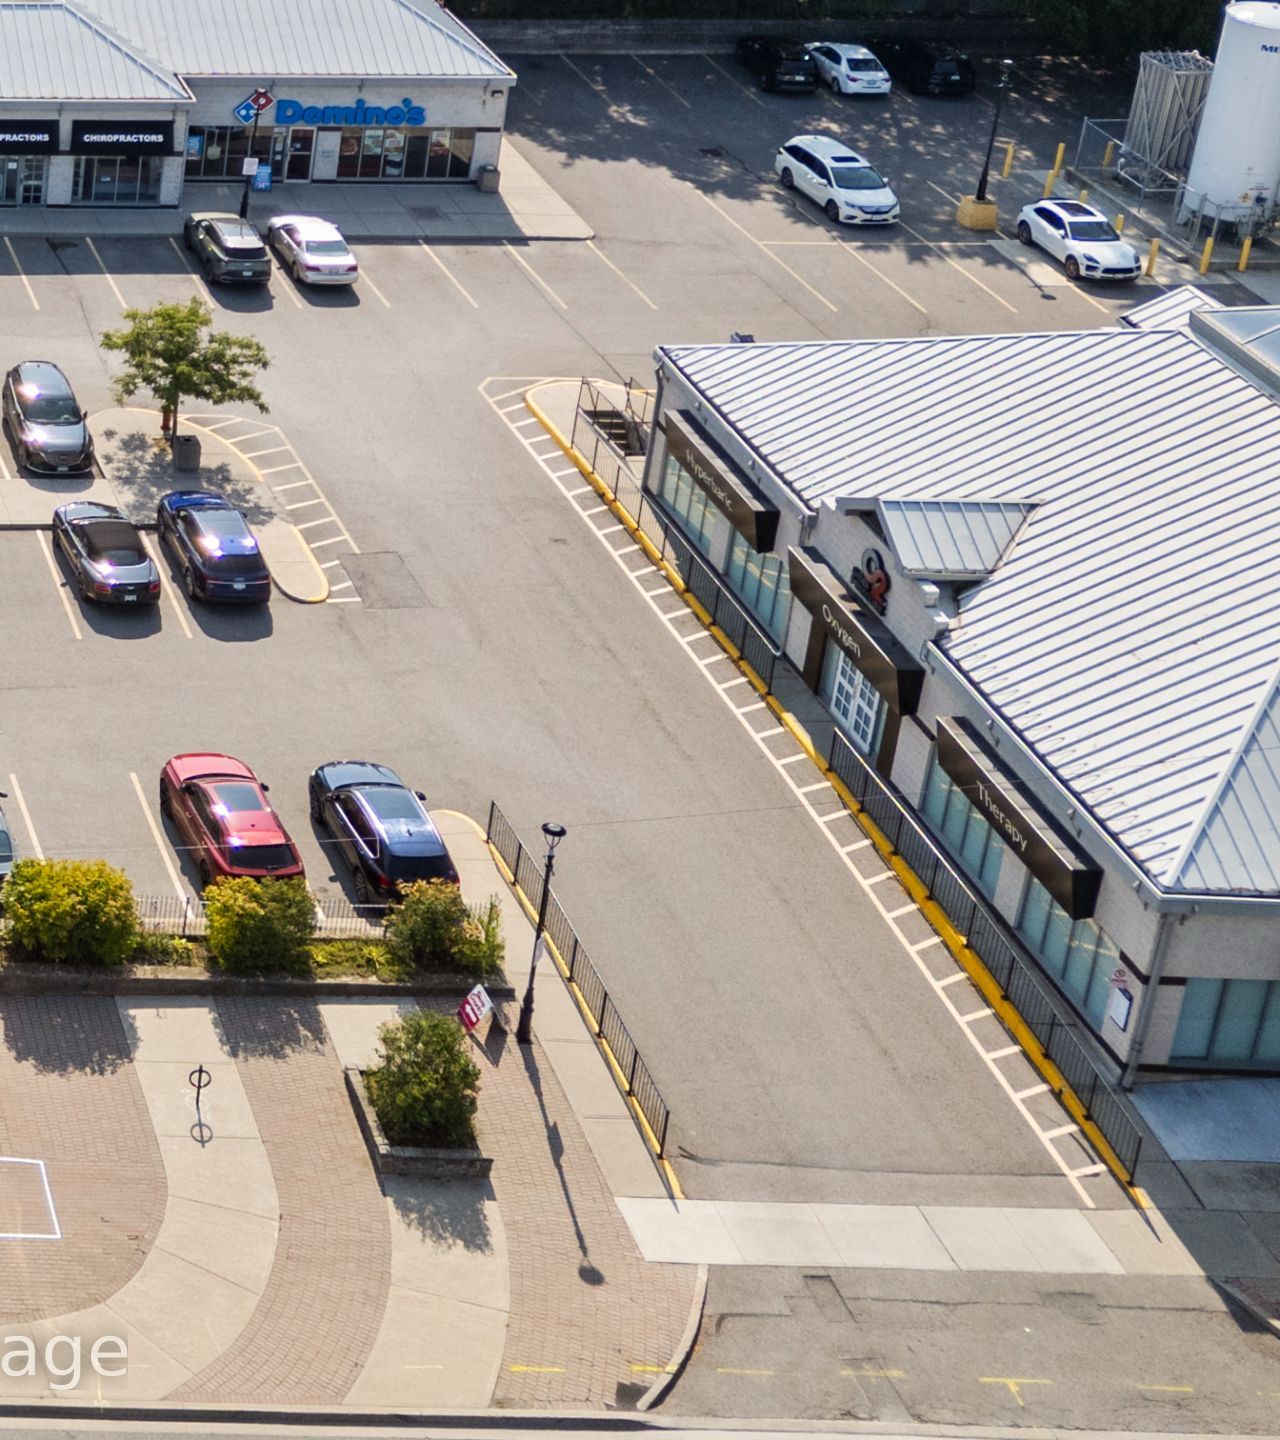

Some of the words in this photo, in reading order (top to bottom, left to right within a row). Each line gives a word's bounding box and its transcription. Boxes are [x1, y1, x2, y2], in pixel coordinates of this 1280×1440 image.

[83, 134, 164, 143] CHIROPRACTORS
[275, 98, 425, 125] Domino's
[686, 449, 733, 512] Hyperbaric
[822, 604, 861, 658] Oxygen
[976, 780, 1028, 852] Therapy
